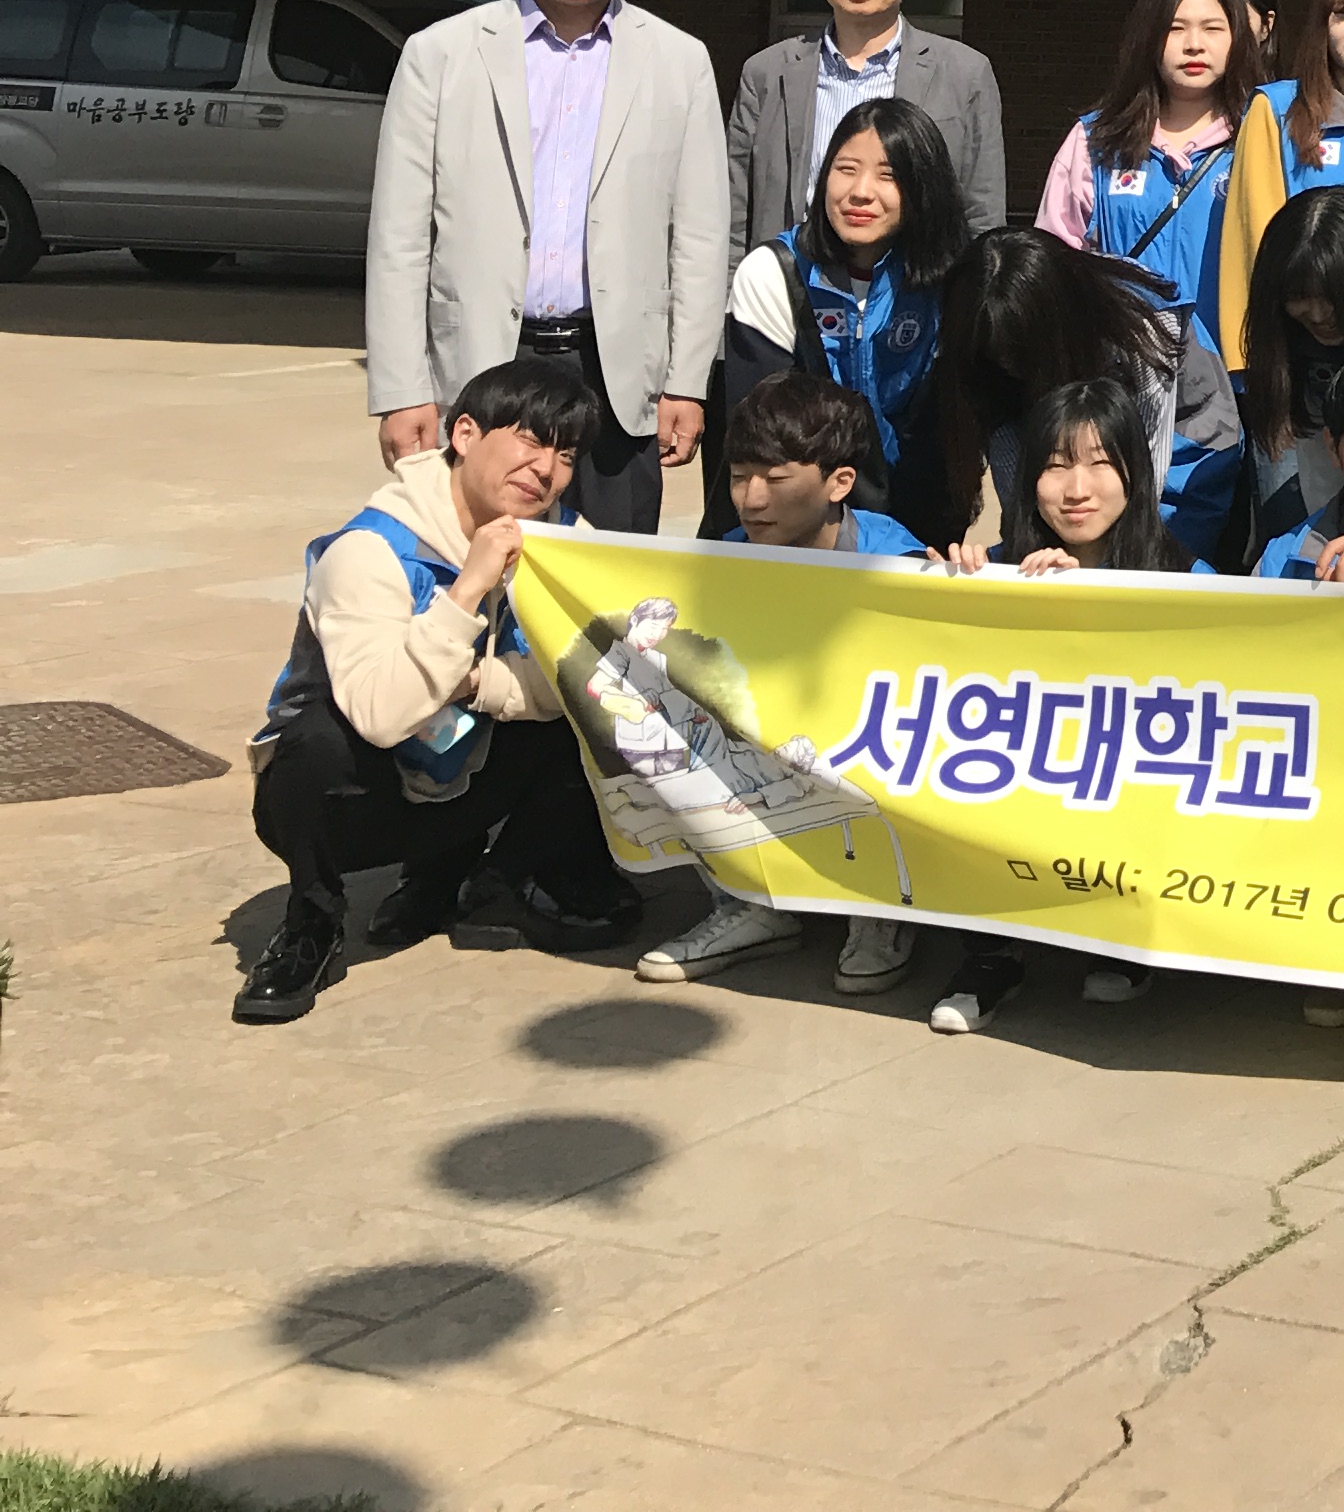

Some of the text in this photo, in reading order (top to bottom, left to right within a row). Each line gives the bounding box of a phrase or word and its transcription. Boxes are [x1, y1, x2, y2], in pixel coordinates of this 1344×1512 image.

[828, 676, 1316, 811] 서영대학교
[1051, 857, 1143, 898] 일시:
[1160, 868, 1311, 921] 2017년
